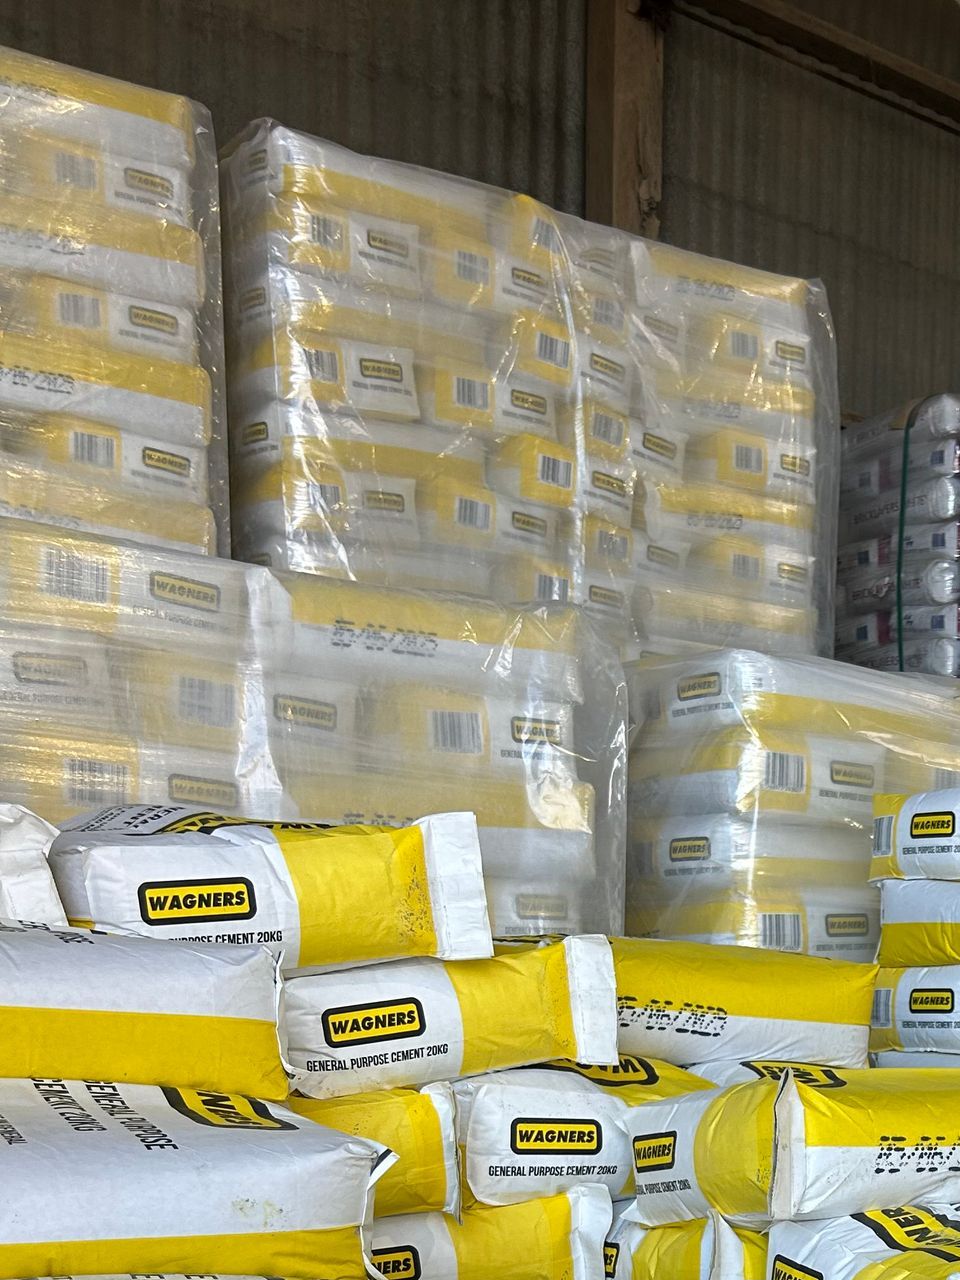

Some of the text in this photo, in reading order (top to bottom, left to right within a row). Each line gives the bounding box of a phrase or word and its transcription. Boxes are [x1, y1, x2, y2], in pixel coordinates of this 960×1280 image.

[914, 820, 951, 830] WAGNERS
[149, 891, 245, 911] WAGNERS
[215, 932, 255, 944] CEMENT
[257, 931, 283, 943] 20KG
[912, 996, 950, 1006] WAGNERS
[331, 1010, 416, 1035] WAGNERS
[306, 1044, 448, 1073] GENERAL PURPOSE CEMENT 20KG
[120, 1117, 179, 1151] PURPOSE
[518, 1130, 595, 1143] WAGNERS
[635, 1143, 672, 1161] WAGNERS
[488, 1165, 617, 1177] GENERAL PURPOSE CEMENT 20KG
